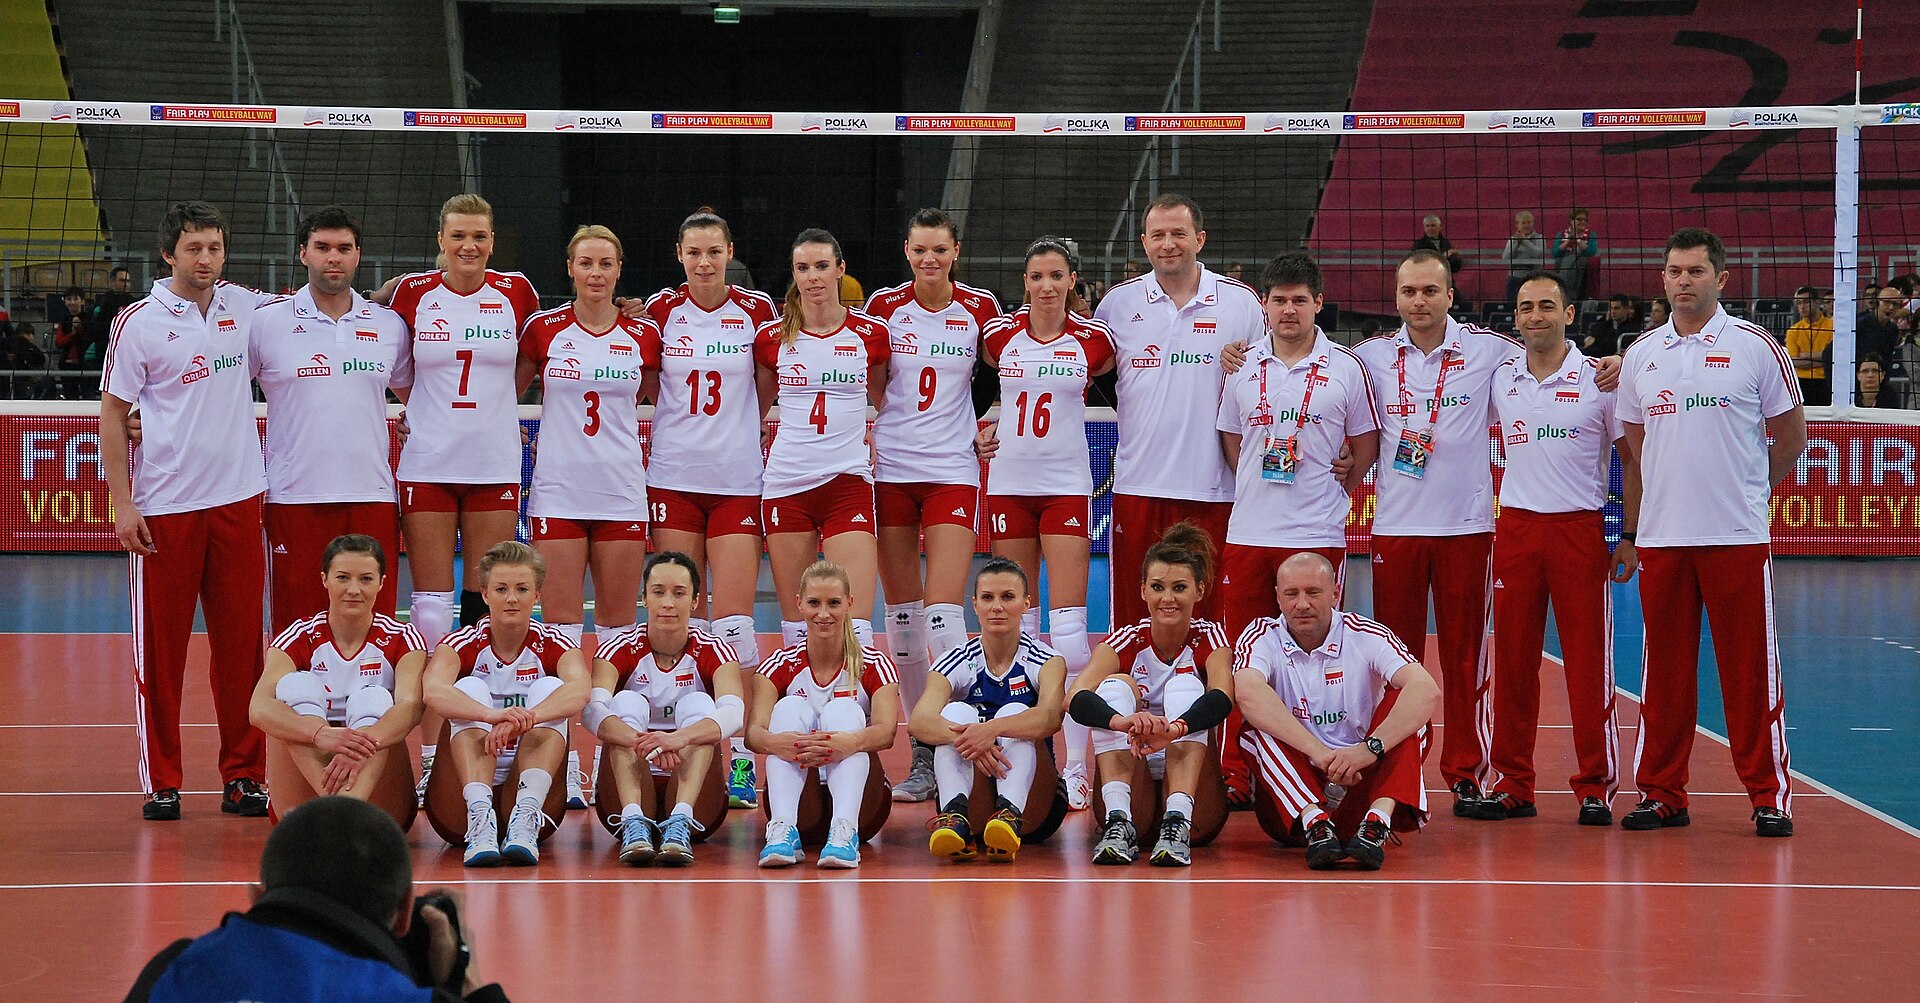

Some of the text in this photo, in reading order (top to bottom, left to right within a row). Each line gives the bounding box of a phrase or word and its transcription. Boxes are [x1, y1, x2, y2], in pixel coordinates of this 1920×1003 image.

[0, 105, 16, 114] WAY
[76, 107, 121, 119] POLSKA
[166, 109, 273, 120] FAIR PLAY VOLLEYBALL WAY
[328, 113, 372, 124] POLSKA
[419, 115, 523, 125] FAIR PLAY VOLLEYBALL WAY
[579, 117, 622, 128] POLSKA
[667, 117, 769, 126] FAIR PLAY VOLLEYBALL WAY
[825, 118, 868, 129] POLSKA
[910, 119, 1012, 128] FAIR PLAY VOLLEYBALL WAY
[1140, 119, 1242, 128] FAIR PLAY VOLLEYBALL WAY
[1288, 118, 1330, 129] POLSKA
[1358, 117, 1461, 126] FAIR PLAY VOLLEYBALL WAY
[1512, 116, 1555, 127] POLSKA
[1598, 113, 1702, 123] FAIR PLAY VOLLEYBALL WAY
[1754, 112, 1798, 123] POLSKA
[1067, 119, 1110, 130] POLSKA
[409, 278, 426, 288] plus
[885, 294, 900, 304] plus
[420, 332, 449, 340] ORLEN
[465, 325, 500, 341] plus
[666, 348, 692, 356] ORLEN
[706, 341, 739, 356] plus
[930, 342, 963, 356] plus
[214, 354, 237, 373] plus
[1133, 359, 1160, 367] ORLEN
[1170, 350, 1201, 366] plus
[299, 367, 329, 377] ORLEN
[343, 357, 375, 375] plus
[456, 349, 473, 396] 7
[1038, 363, 1074, 378] plus
[549, 368, 579, 378] ORLEN
[594, 366, 629, 381] plus
[821, 369, 856, 385] plus
[685, 369, 722, 416] 13
[918, 366, 937, 412] 9
[1426, 396, 1458, 412] pus
[1686, 392, 1717, 412] plus
[582, 391, 600, 437] 3
[809, 391, 828, 435] 4
[1015, 391, 1053, 438] 16
[1649, 404, 1675, 415] ORLEN
[1537, 424, 1567, 440] plus
[1796, 437, 1917, 486] AIR
[406, 486, 413, 506] 7
[651, 502, 667, 523] 13
[771, 506, 779, 526] 4
[539, 517, 548, 535] 3
[991, 513, 1007, 533] 16
